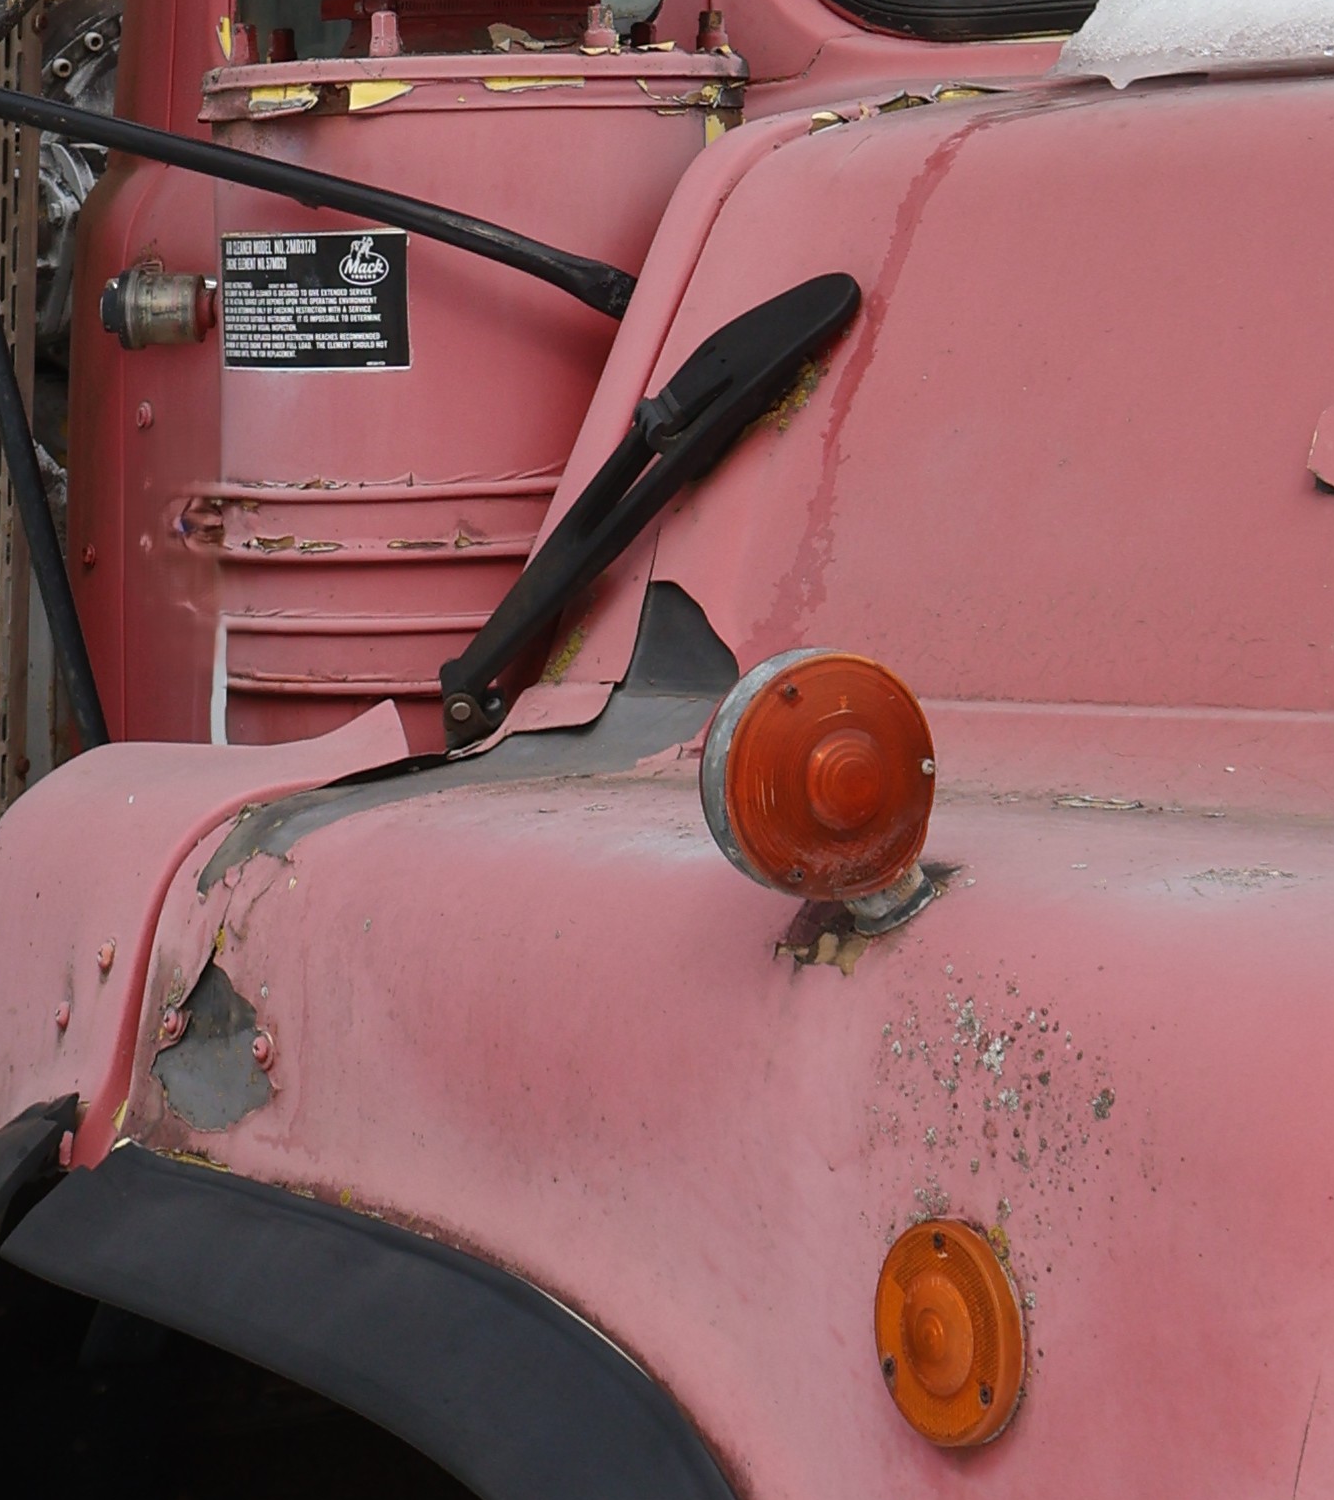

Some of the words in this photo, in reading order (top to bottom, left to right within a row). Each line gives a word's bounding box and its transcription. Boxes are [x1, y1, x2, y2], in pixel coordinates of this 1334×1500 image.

[253, 240, 272, 254] MODEL
[274, 239, 285, 254] NO.
[344, 258, 384, 274] Mack
[278, 289, 299, 297] DESIGNED
[300, 289, 307, 297] TO
[308, 289, 319, 297] GIVE
[321, 288, 347, 296] EXTENDED
[349, 288, 372, 296] SERVICE
[339, 296, 377, 304] ENVIRONMENT
[348, 305, 372, 313] SERVICE
[310, 315, 339, 323] IMPOSSIBLE
[341, 314, 349, 322] TO
[350, 314, 381, 322] DETERMINE
[339, 332, 381, 340] RECOMMENDED
[316, 341, 325, 349] THE
[327, 341, 351, 349] ELEMENT
[352, 340, 375, 348] SHOULD
[376, 340, 388, 348] NOT
